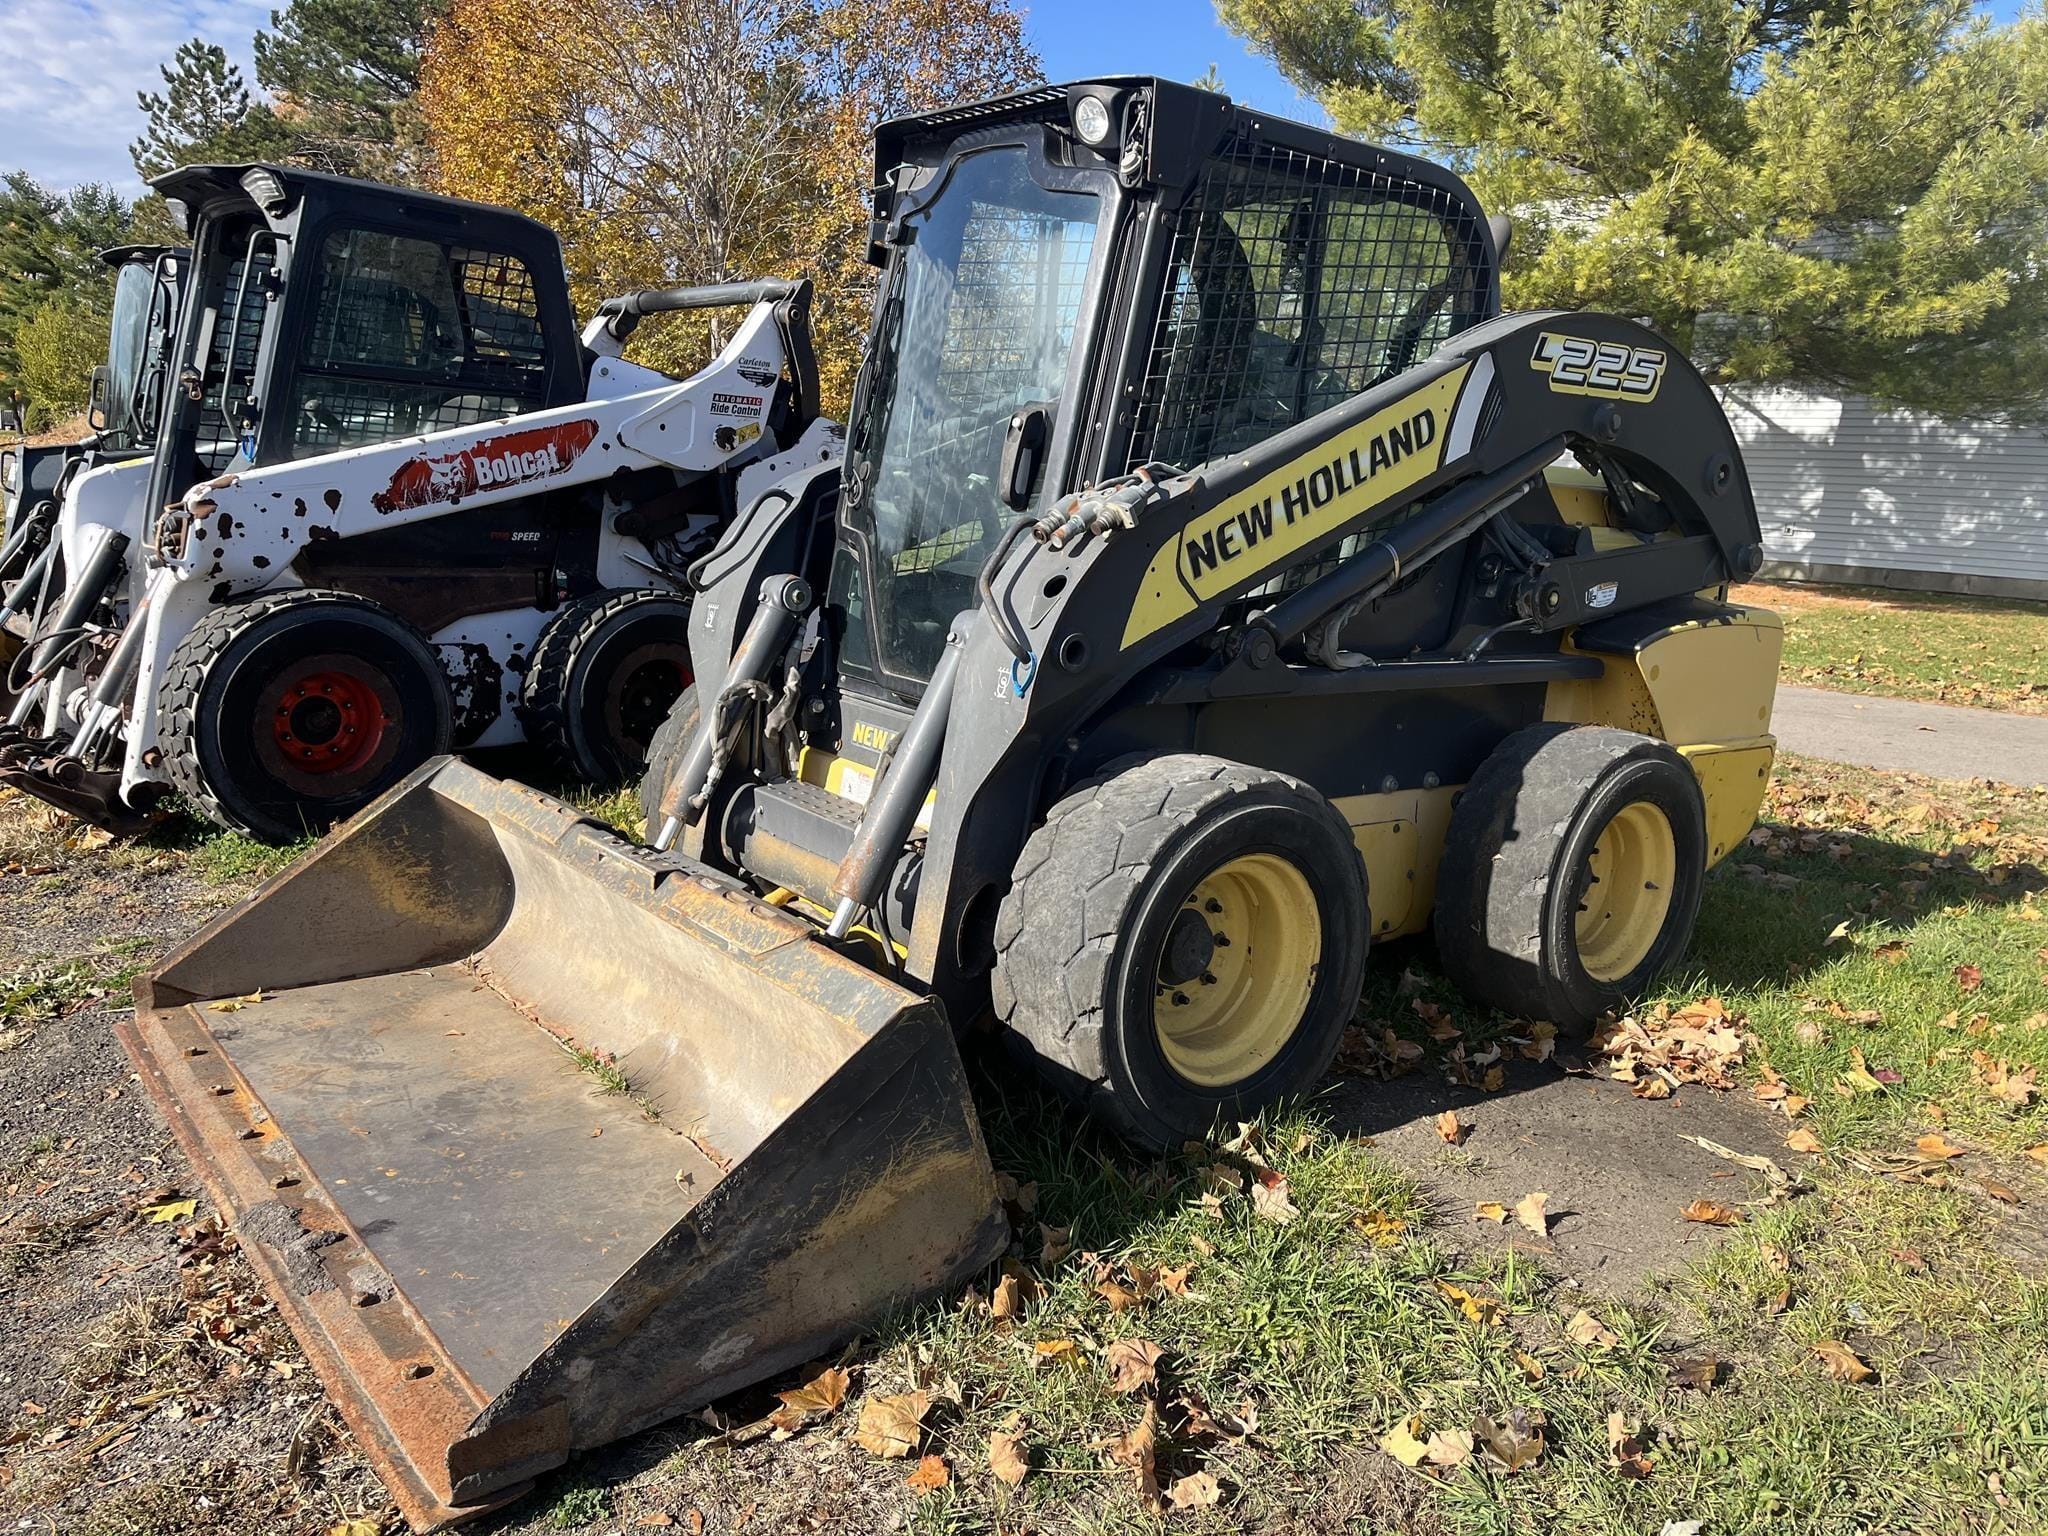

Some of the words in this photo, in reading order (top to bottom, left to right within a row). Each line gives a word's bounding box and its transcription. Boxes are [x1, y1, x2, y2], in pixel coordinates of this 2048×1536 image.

[738, 357, 771, 368] Carleton
[1531, 333, 1666, 400] L225
[710, 402, 730, 413] Ride
[731, 404, 761, 416] Control
[714, 394, 762, 405] AUTOMATIC
[473, 442, 560, 486] Bobcat
[1185, 496, 1273, 581] NEW
[1281, 407, 1436, 527] HOLLAND
[511, 532, 541, 541] SPEED
[852, 722, 888, 751] NEW
